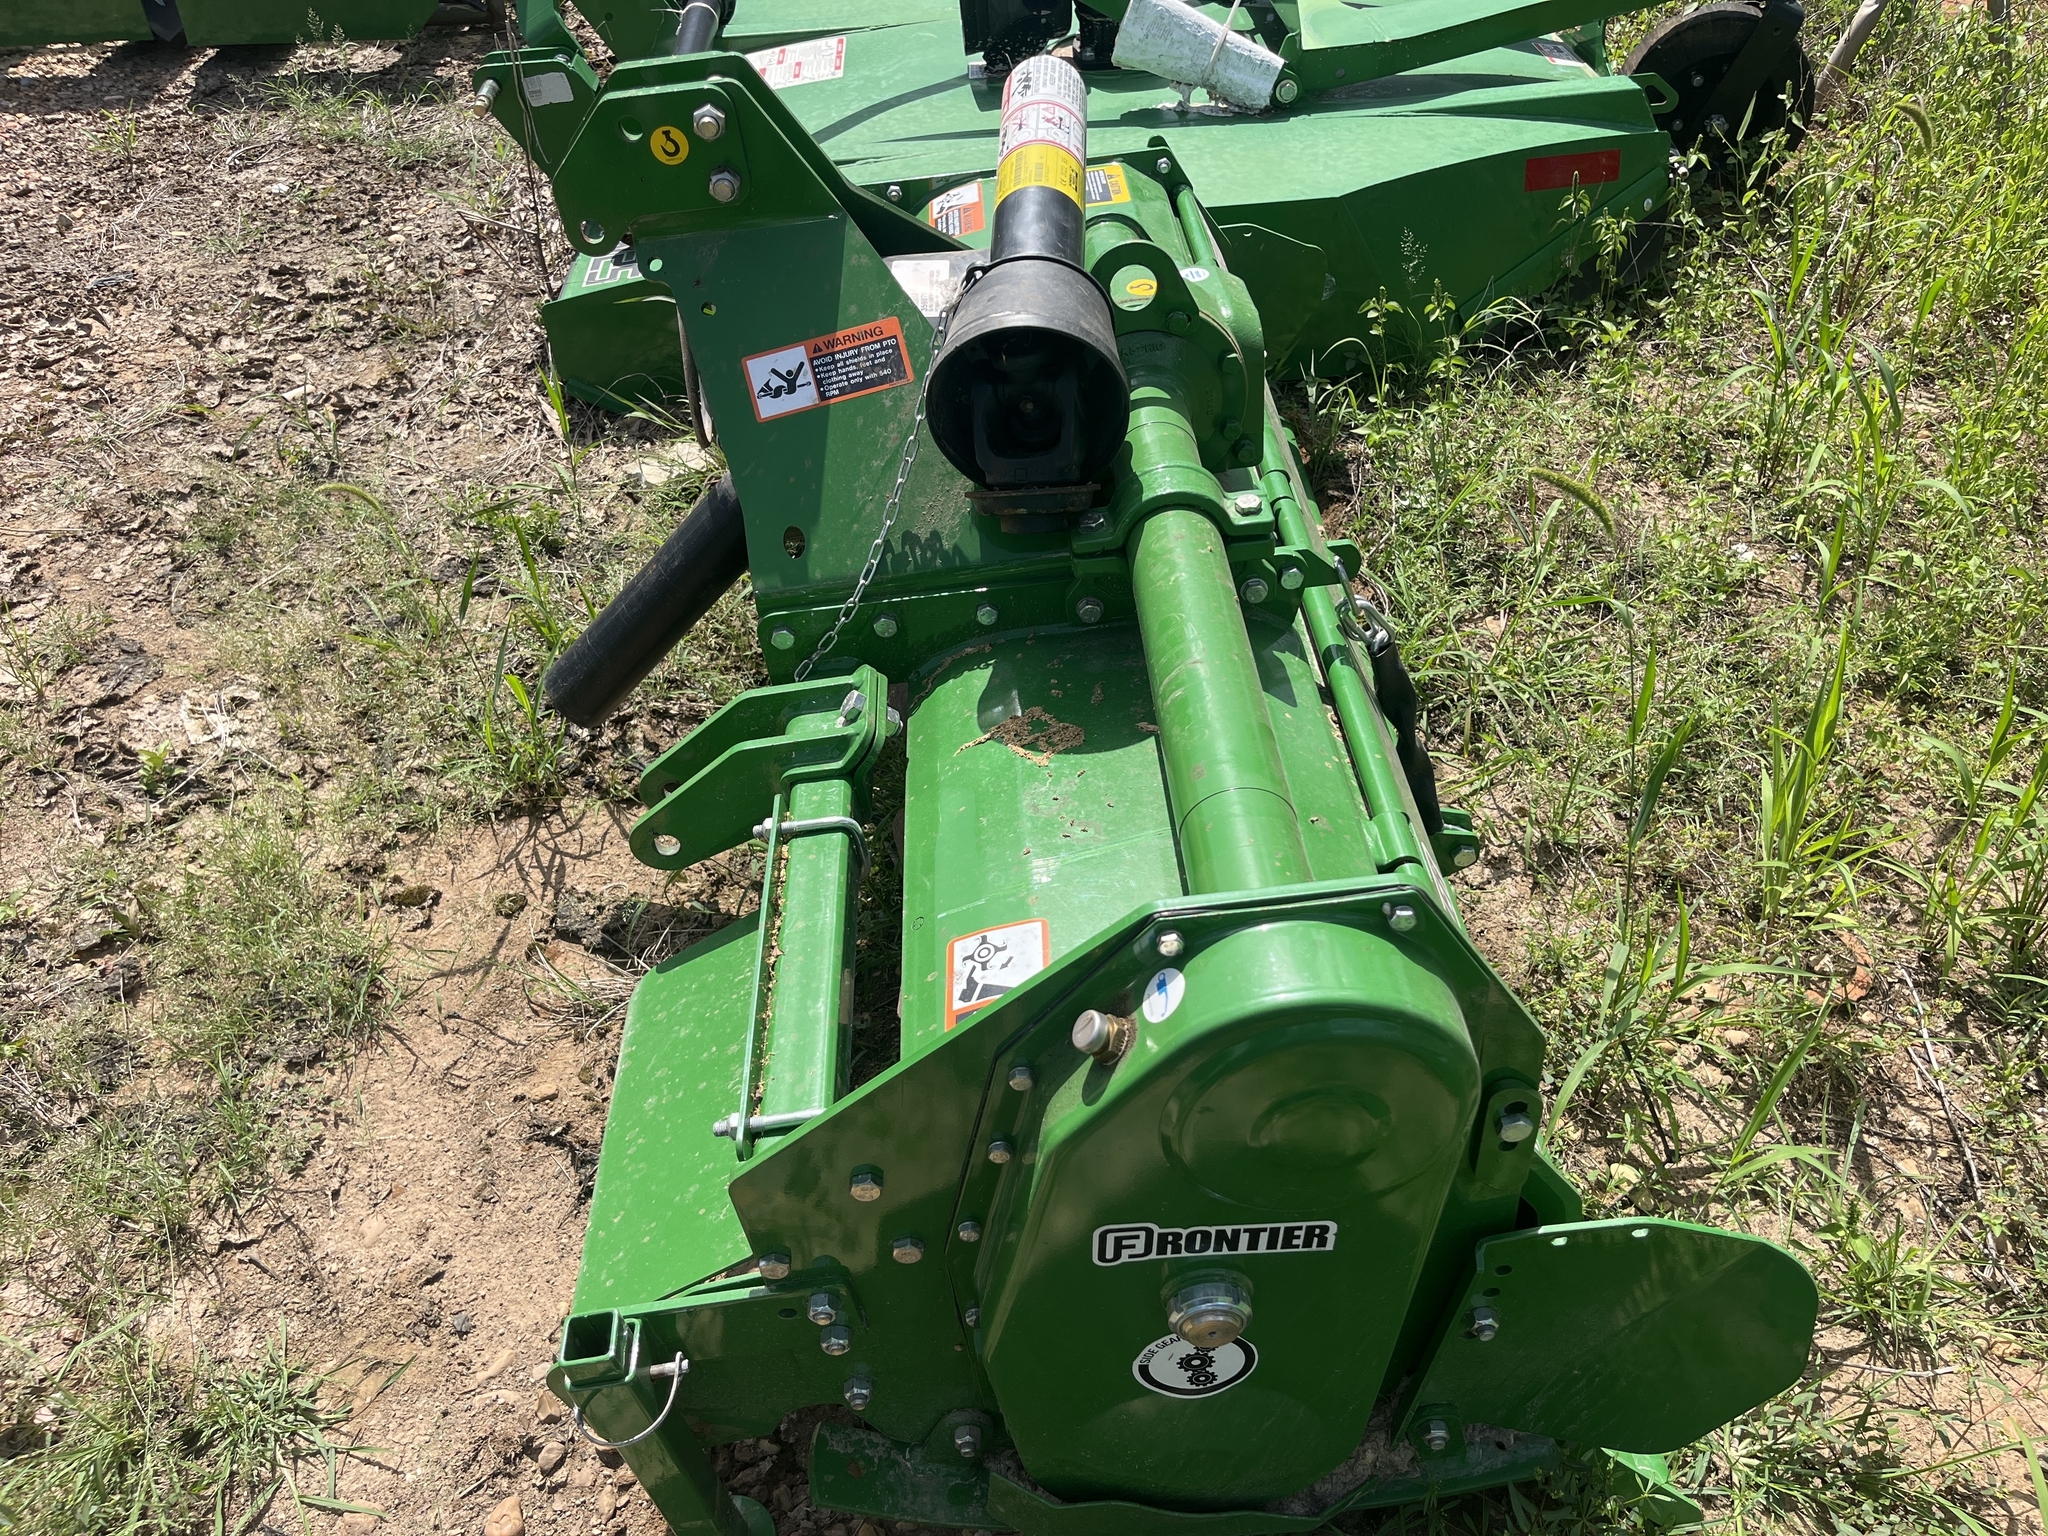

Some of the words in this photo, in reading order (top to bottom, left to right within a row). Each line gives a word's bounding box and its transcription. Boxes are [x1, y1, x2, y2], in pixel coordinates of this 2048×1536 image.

[823, 326, 884, 349] WARNING
[813, 356, 832, 366] AVOID
[835, 349, 858, 360] INJURY
[861, 343, 881, 353] FROM
[883, 339, 896, 347] PTO
[819, 364, 835, 372] Keep
[846, 355, 867, 365] shields
[876, 348, 892, 358] place
[821, 370, 837, 379] Keep
[823, 374, 847, 385] clothing
[824, 381, 848, 391] Operate
[880, 369, 891, 377] 540
[1097, 1224, 1331, 1264] FRONTIER
[1139, 1348, 1159, 1364] SIDE
